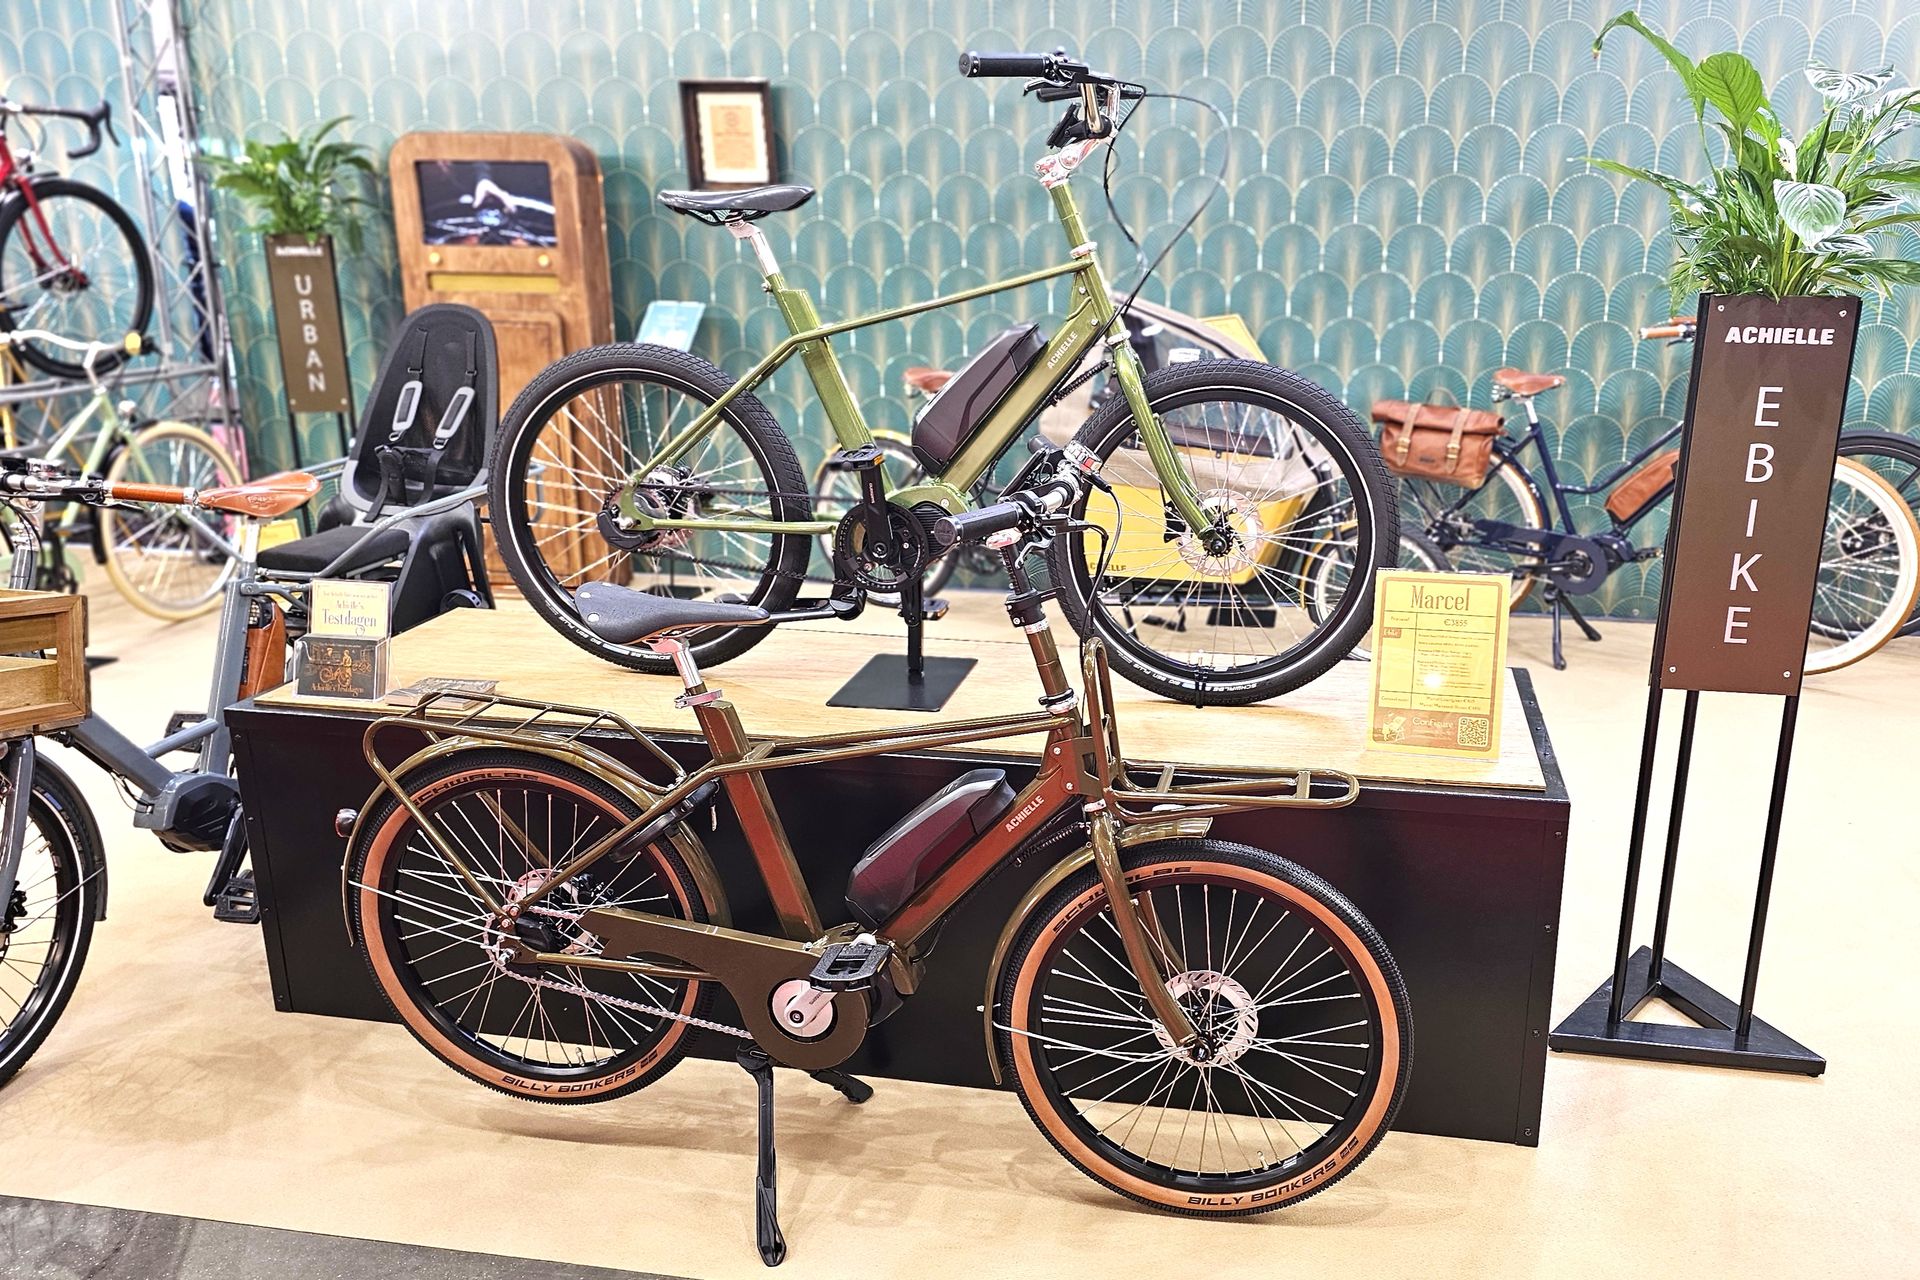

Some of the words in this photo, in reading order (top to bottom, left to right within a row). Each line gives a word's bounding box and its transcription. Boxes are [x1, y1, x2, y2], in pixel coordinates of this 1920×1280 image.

[294, 274, 326, 392] URBAN
[1047, 331, 1078, 369] ACHIELLE
[1725, 326, 1835, 346] ACHIELLE
[1723, 386, 1784, 644] EBIKE
[1410, 585, 1471, 611] Marcel
[322, 609, 377, 636] Testdagen
[1005, 795, 1045, 832] ACHIELLE
[501, 1075, 553, 1093] BILLY
[557, 1065, 636, 1093] BONKERS
[1187, 1196, 1244, 1206] BILLY
[1250, 1158, 1337, 1203] BONKERS
